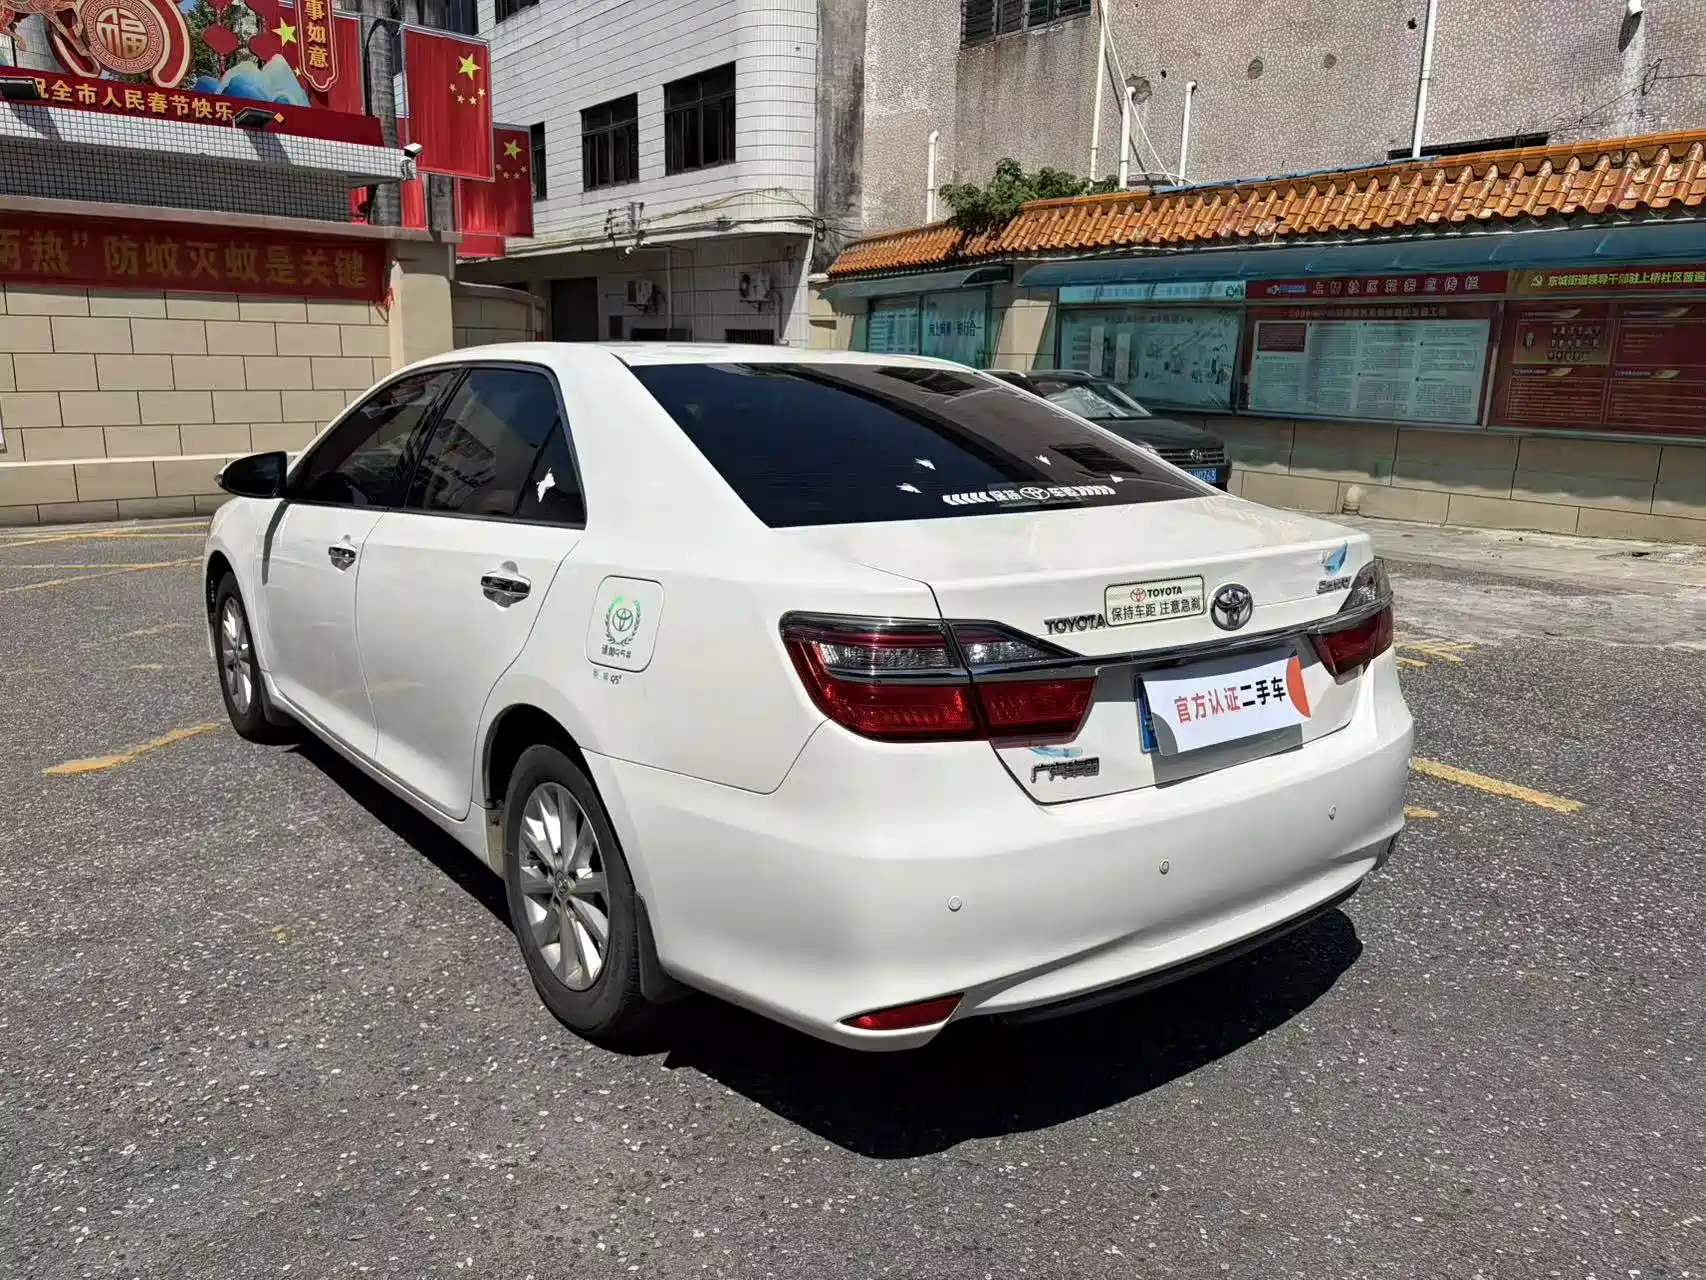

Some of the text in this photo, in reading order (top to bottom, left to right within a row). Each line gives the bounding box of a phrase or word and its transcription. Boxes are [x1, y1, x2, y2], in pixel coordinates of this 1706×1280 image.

[97, 8, 149, 59] 福
[304, 0, 329, 68] 事如意
[1147, 586, 1183, 598] TOYOTA
[1044, 614, 1106, 635] TOYOTA
[1111, 604, 1157, 621] 保持车距
[1174, 677, 1287, 724] 官方认证二手车
